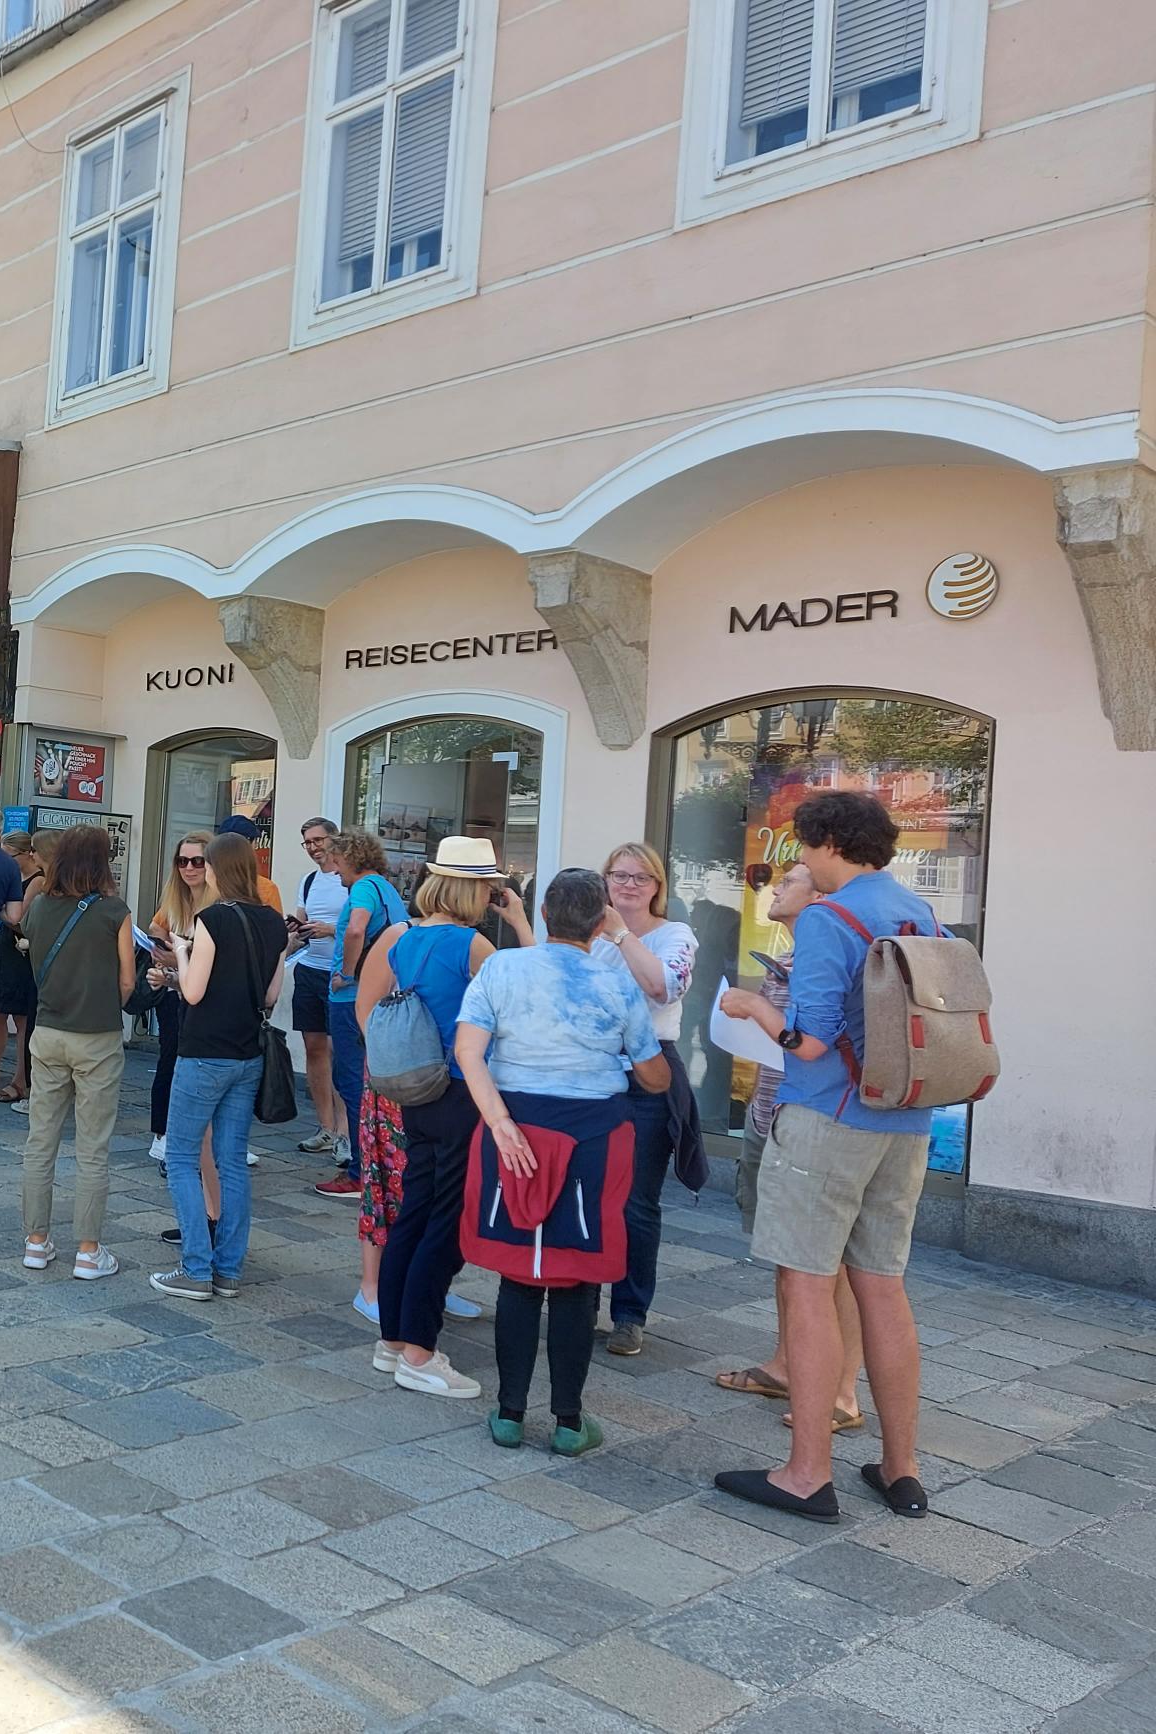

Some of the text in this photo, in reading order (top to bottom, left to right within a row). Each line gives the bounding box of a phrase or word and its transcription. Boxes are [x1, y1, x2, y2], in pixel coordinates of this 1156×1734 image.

[729, 589, 899, 633] MADER
[345, 628, 558, 669] REISECENTER
[146, 663, 234, 691] KUONI
